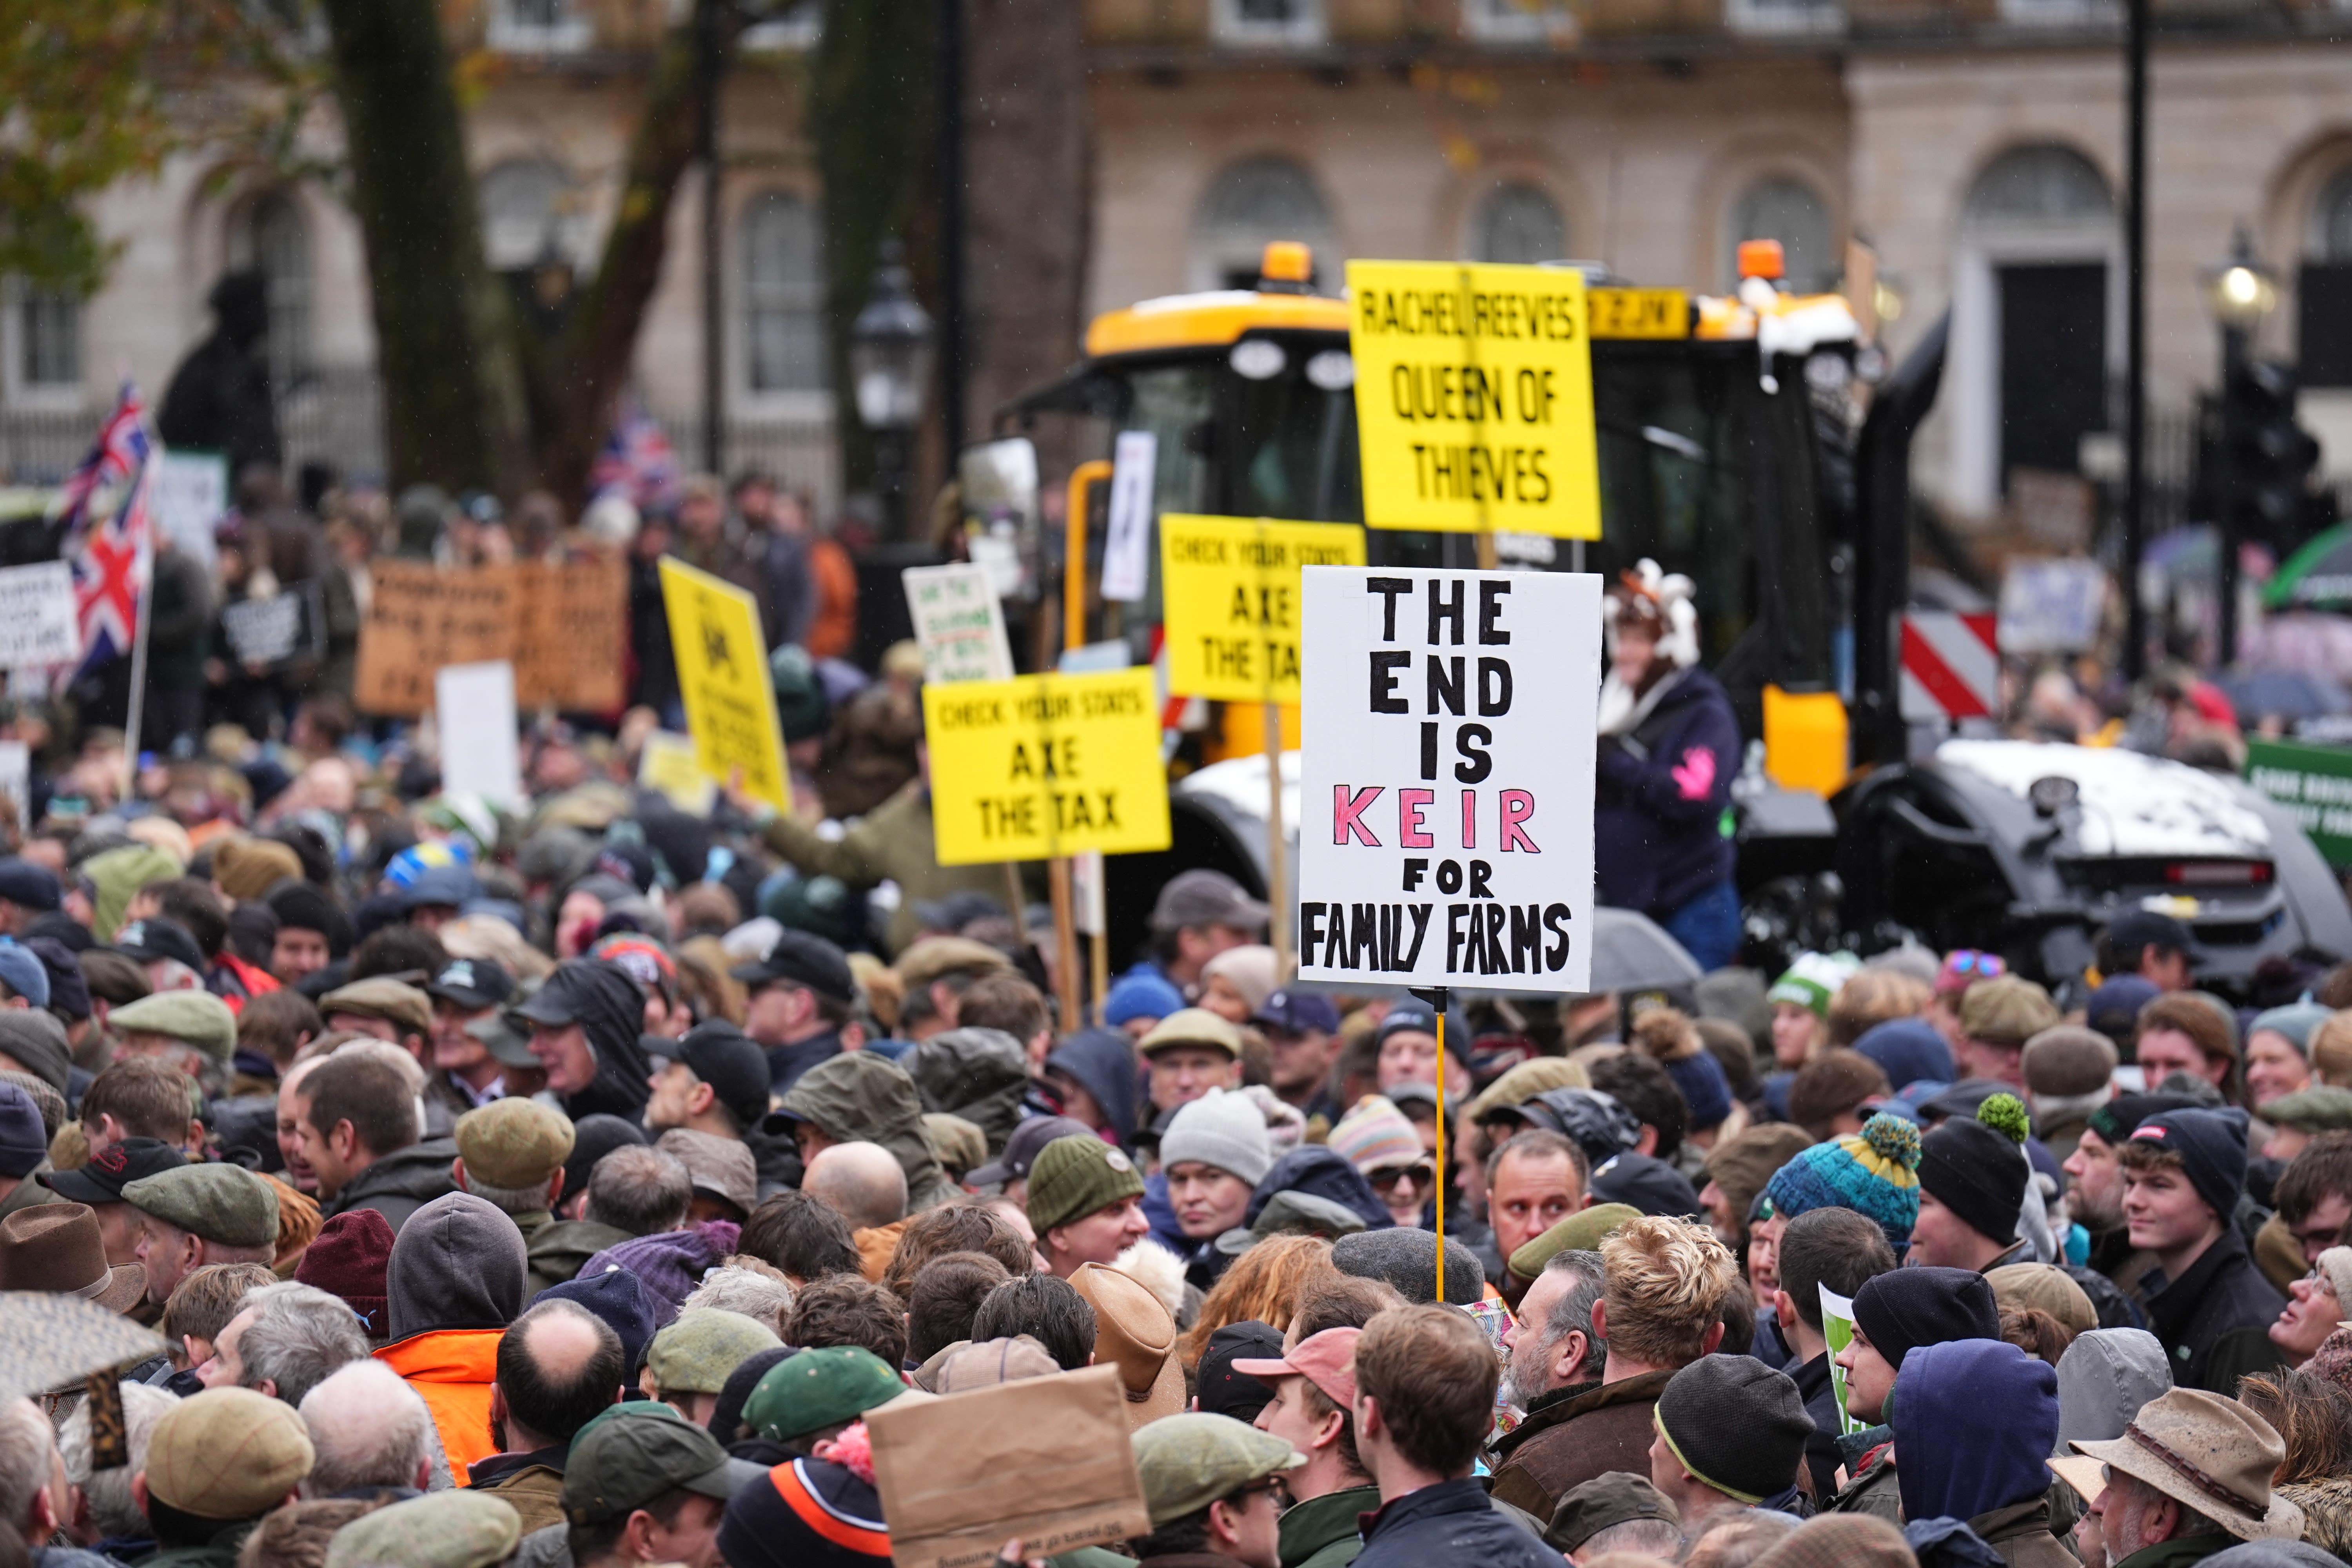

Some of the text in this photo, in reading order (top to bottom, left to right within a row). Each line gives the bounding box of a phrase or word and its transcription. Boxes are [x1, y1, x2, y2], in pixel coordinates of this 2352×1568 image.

[1360, 290, 1573, 341] RACHEL REEVES
[1392, 365, 1557, 424] QUEEN OF
[1410, 444, 1551, 503] THIEVES
[1171, 536, 1228, 563] CHECK
[1236, 539, 1287, 567] YOUR
[1230, 587, 1293, 627] AXE
[1367, 577, 1511, 646] THE
[1200, 636, 1300, 684] THE TA
[1370, 650, 1513, 717] END
[938, 688, 1145, 728] CHECK YOUR STATS
[1009, 737, 1080, 779] AXE
[1420, 722, 1492, 784] IS
[977, 791, 1123, 840] THE TAX
[1333, 784, 1541, 854] KEIR
[1402, 858, 1495, 898] FOR
[1300, 902, 1572, 975] FAMILY FARMS
